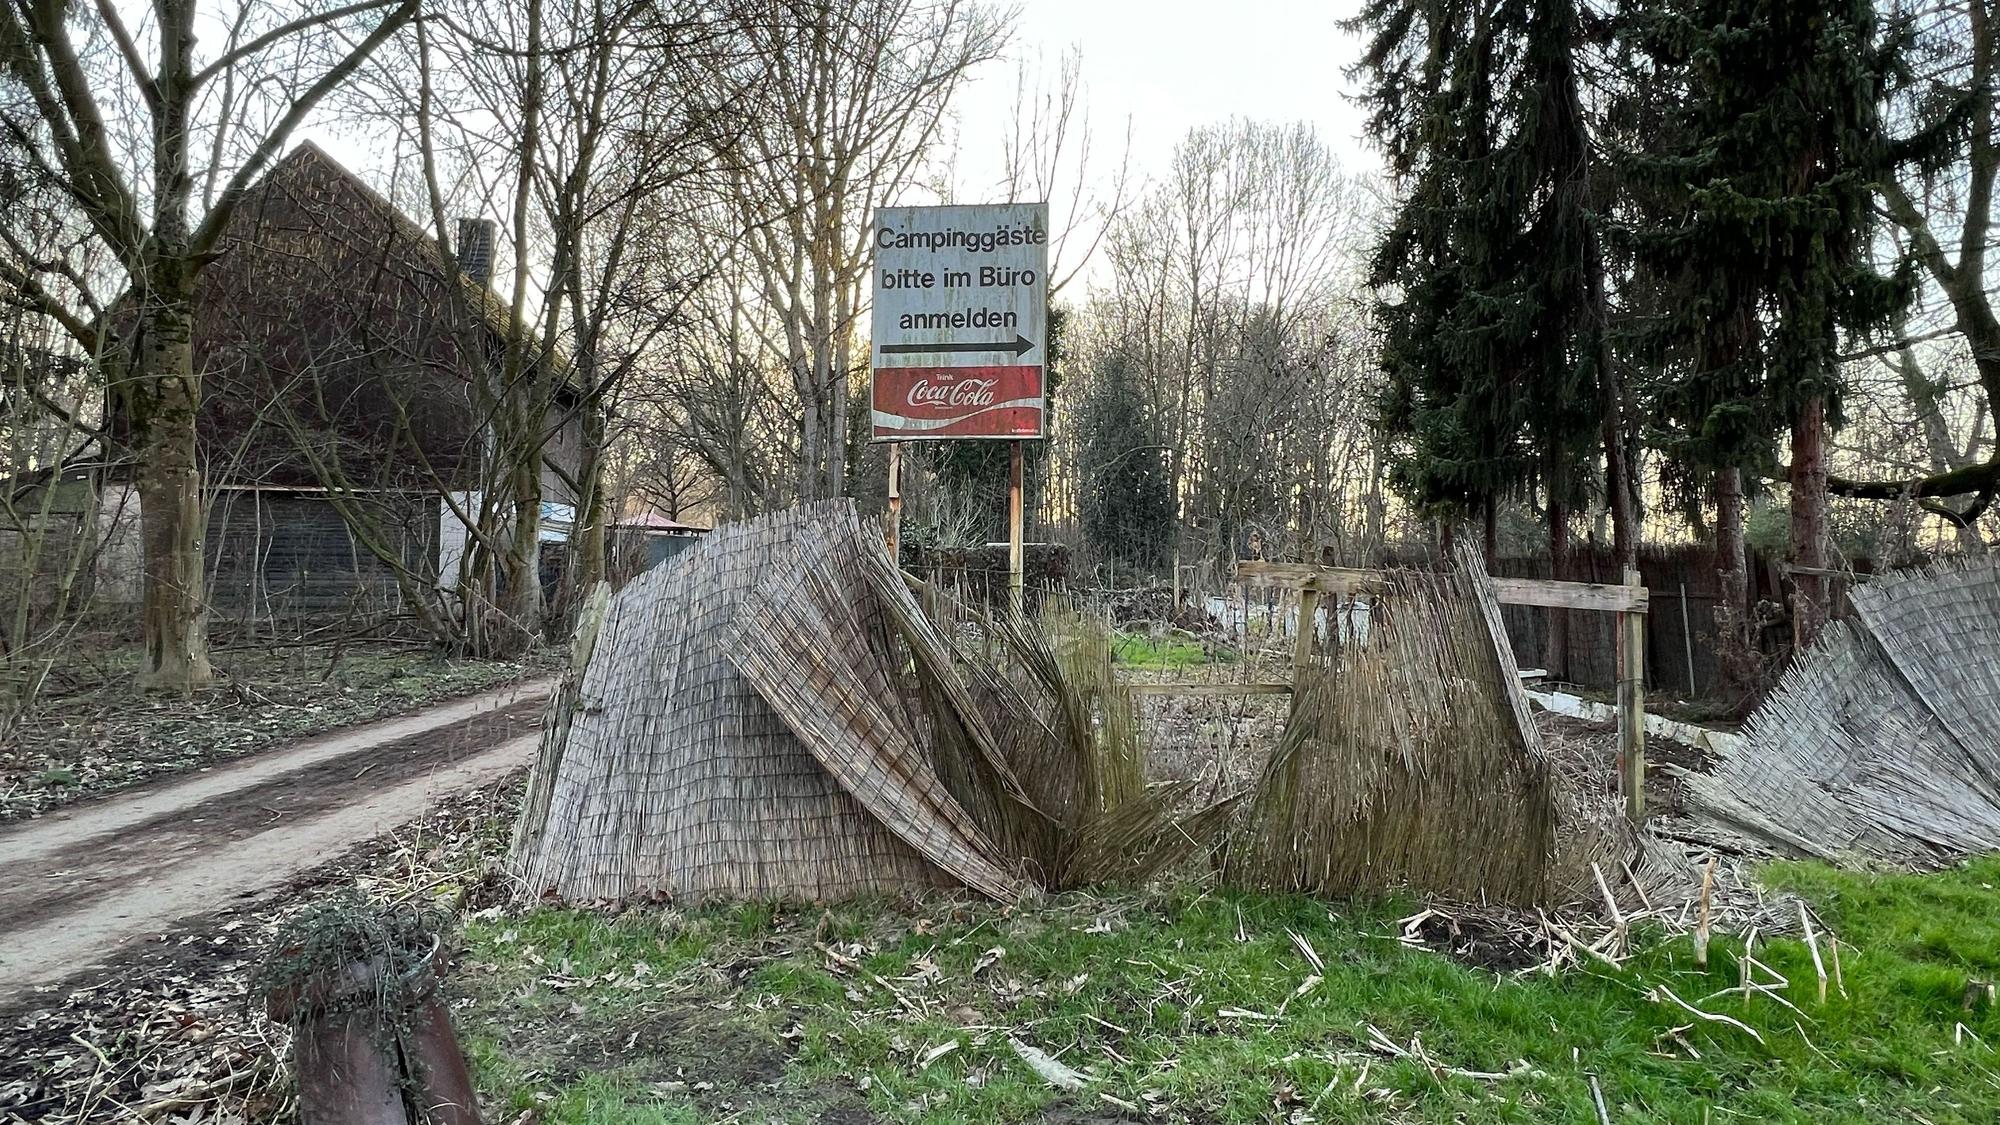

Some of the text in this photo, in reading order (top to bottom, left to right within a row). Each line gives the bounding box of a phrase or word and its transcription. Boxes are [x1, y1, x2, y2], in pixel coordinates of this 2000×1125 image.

[876, 224, 1047, 254] Campinggäste
[881, 266, 1036, 290] bitte im Büro
[899, 307, 1018, 330] anmelden
[907, 378, 999, 407] Coca-Cola
